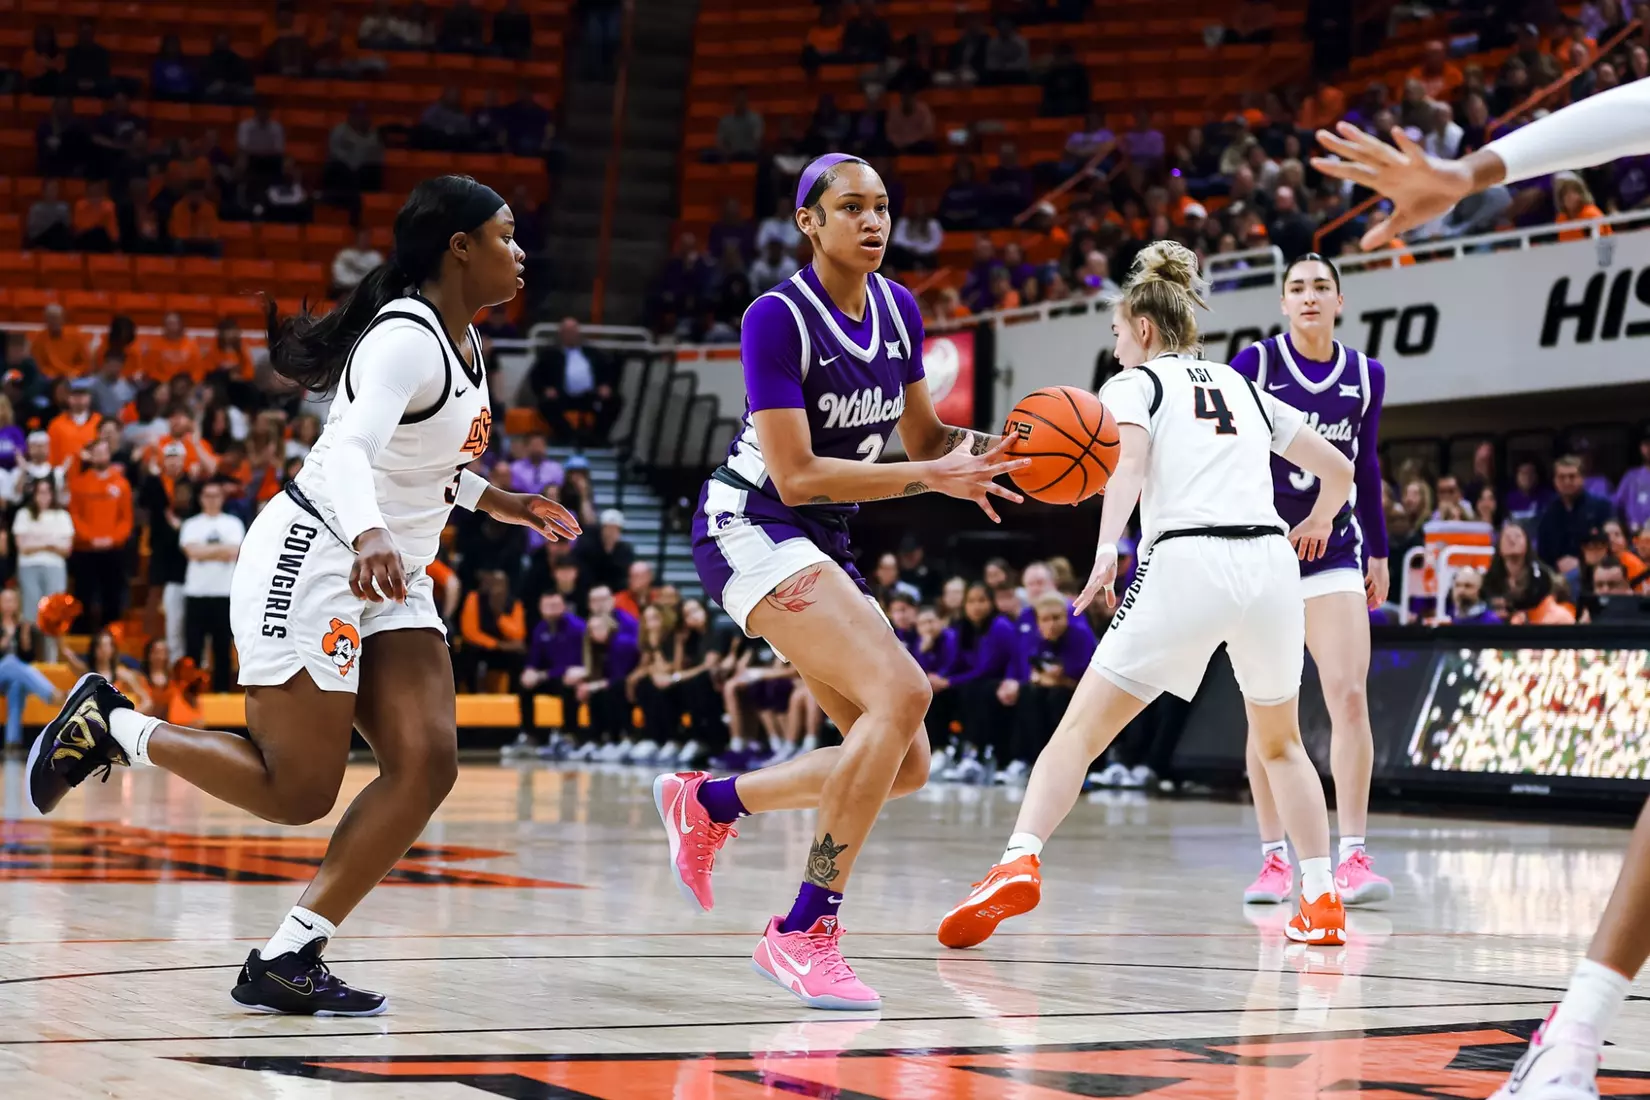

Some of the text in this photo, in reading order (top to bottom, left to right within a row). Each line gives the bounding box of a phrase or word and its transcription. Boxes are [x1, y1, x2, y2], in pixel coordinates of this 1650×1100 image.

[1359, 303, 1440, 359] TO
[1186, 367, 1213, 382] ASI
[818, 381, 906, 429] Wildcat
[1194, 385, 1238, 435] 4
[856, 433, 884, 464] 2
[262, 523, 318, 639] COWGIRLS
